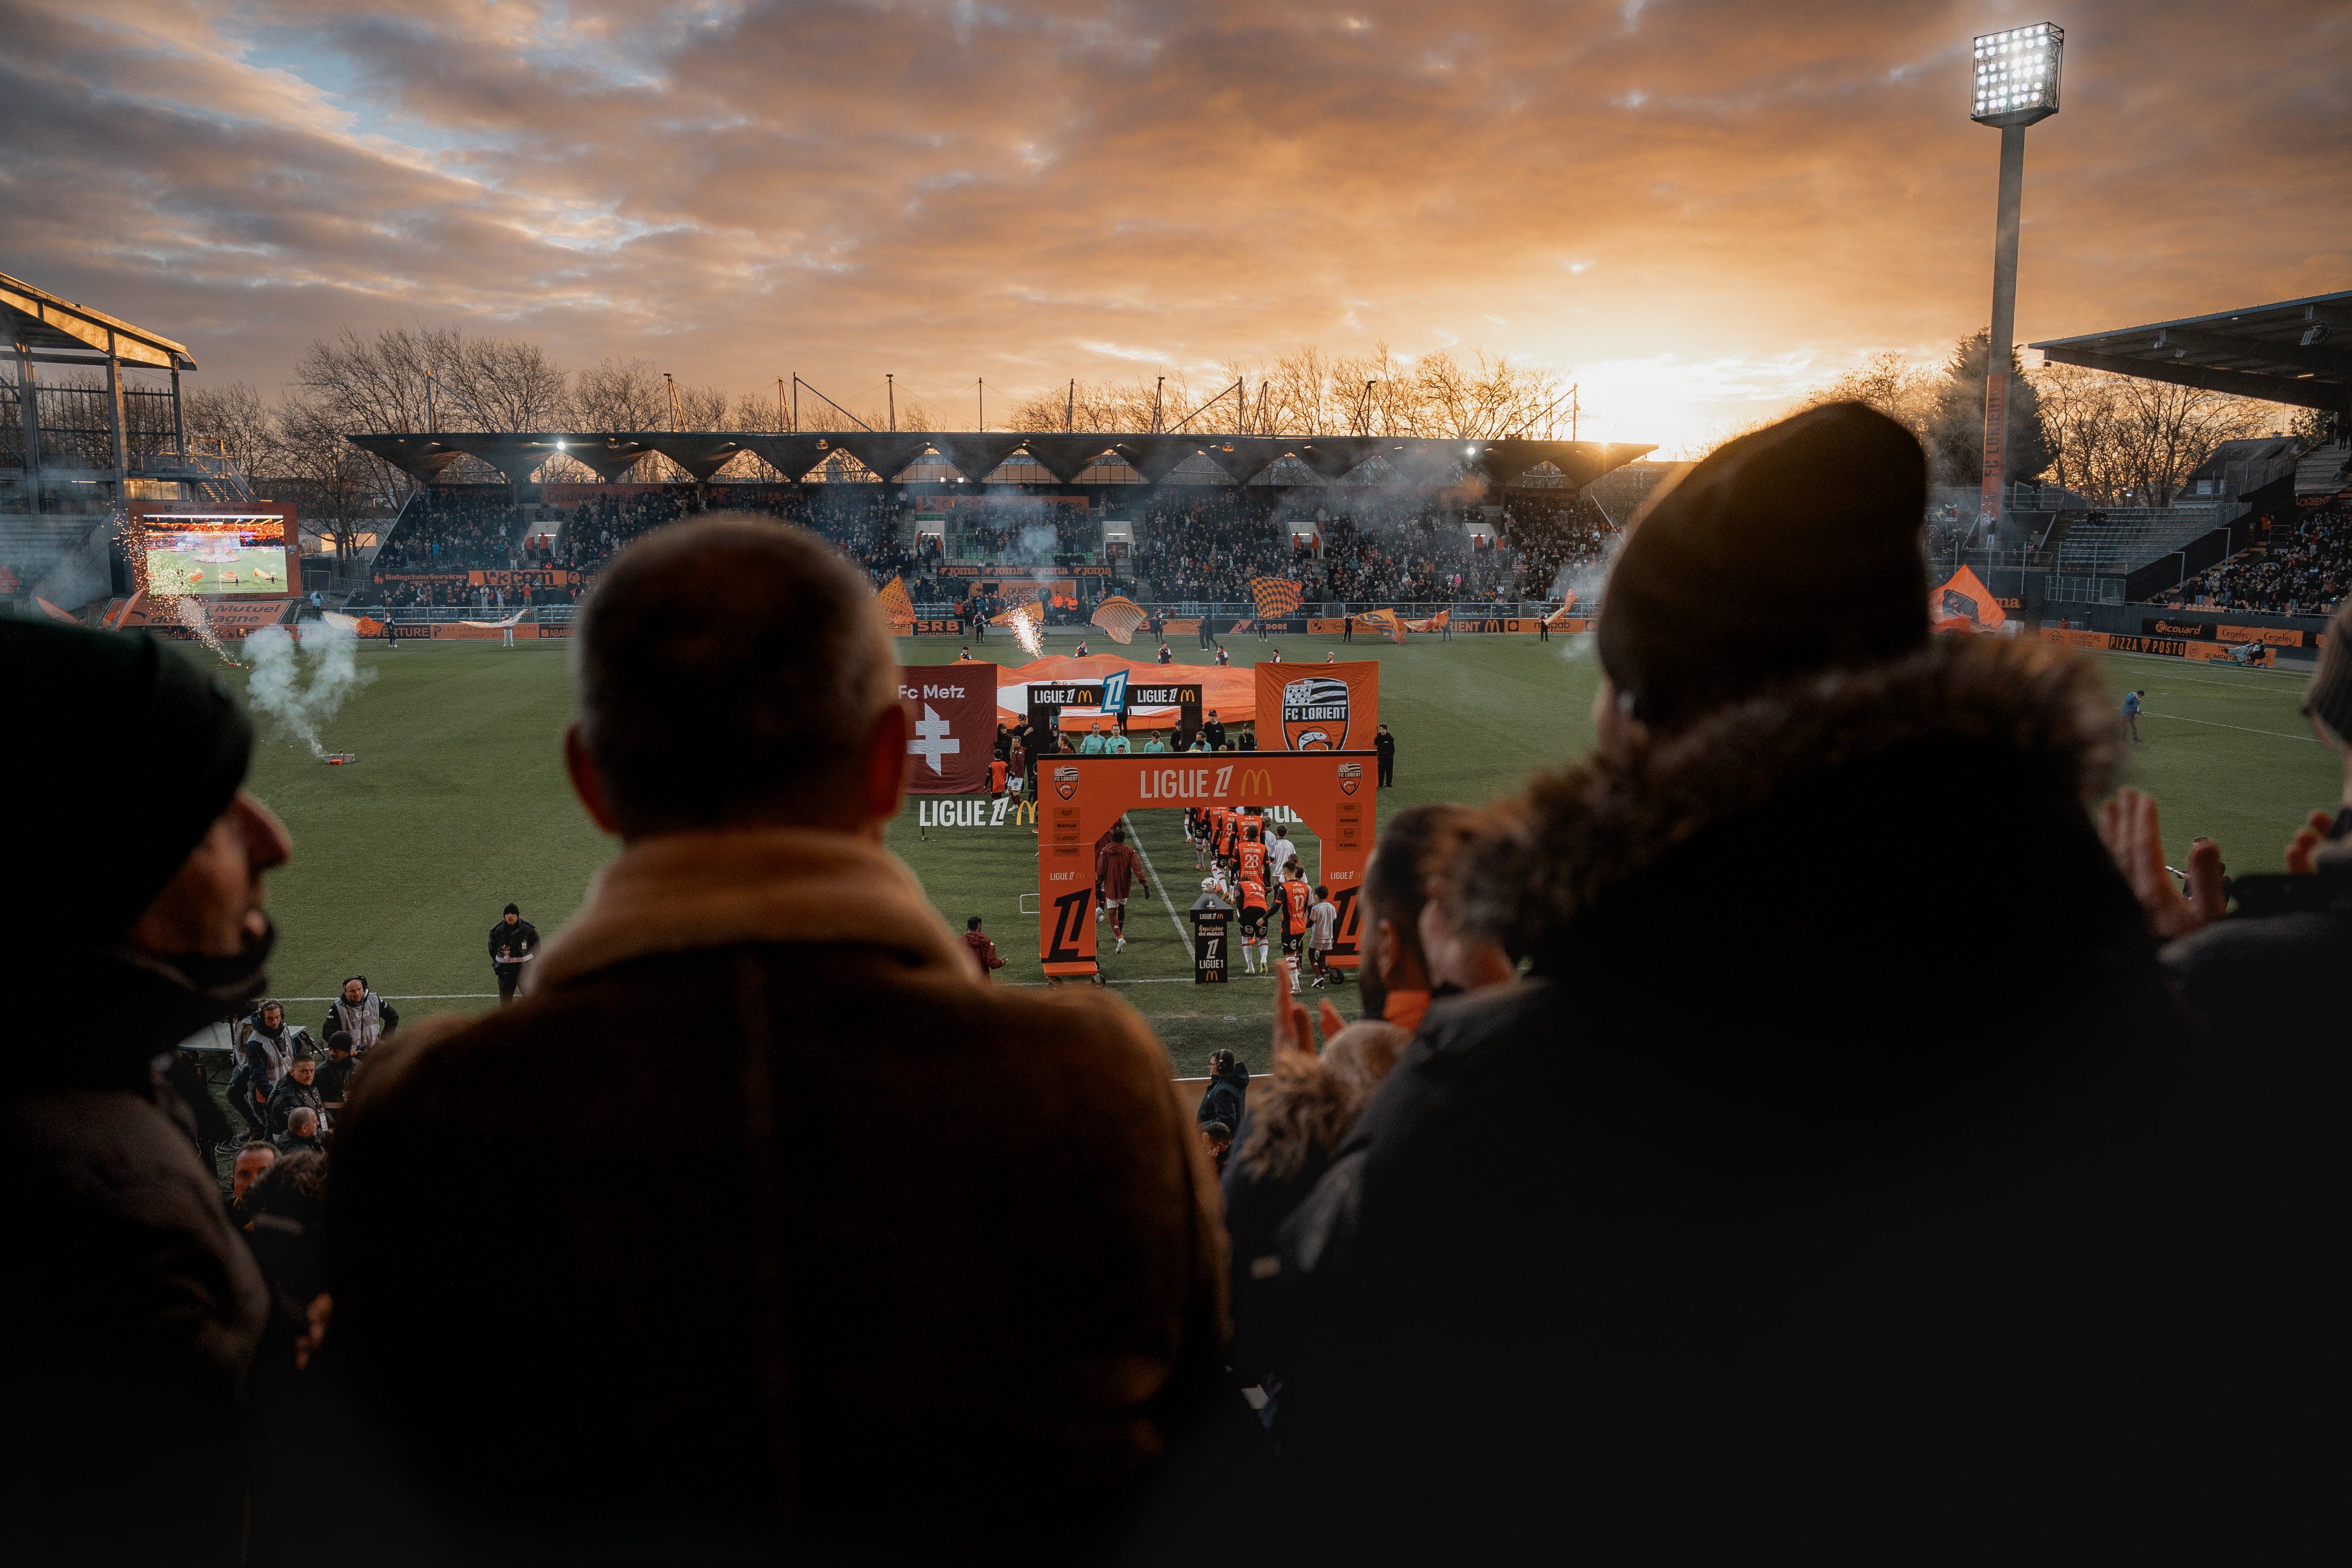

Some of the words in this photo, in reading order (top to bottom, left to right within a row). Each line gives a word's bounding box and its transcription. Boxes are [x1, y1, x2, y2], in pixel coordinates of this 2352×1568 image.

[1984, 460, 1998, 477] FC
[215, 604, 281, 613] Mutuel
[918, 621, 959, 631] SRB
[2110, 636, 2137, 651] PIZZA
[2152, 640, 2184, 655] POSTO
[898, 684, 918, 699] Fc
[923, 684, 965, 699] Metz
[1034, 690, 1065, 703] LIGUE
[1138, 689, 1167, 703] LIGUE
[1285, 708, 1298, 721] FC
[1302, 707, 1346, 720] LORIENT
[1140, 769, 1209, 799] LIGUE
[919, 800, 987, 827] LIGUE
[1245, 854, 1259, 868] 28
[1050, 873, 1068, 881] LIGUE
[1330, 872, 1348, 880] LIGUE
[1199, 924, 1224, 933] Équipier
